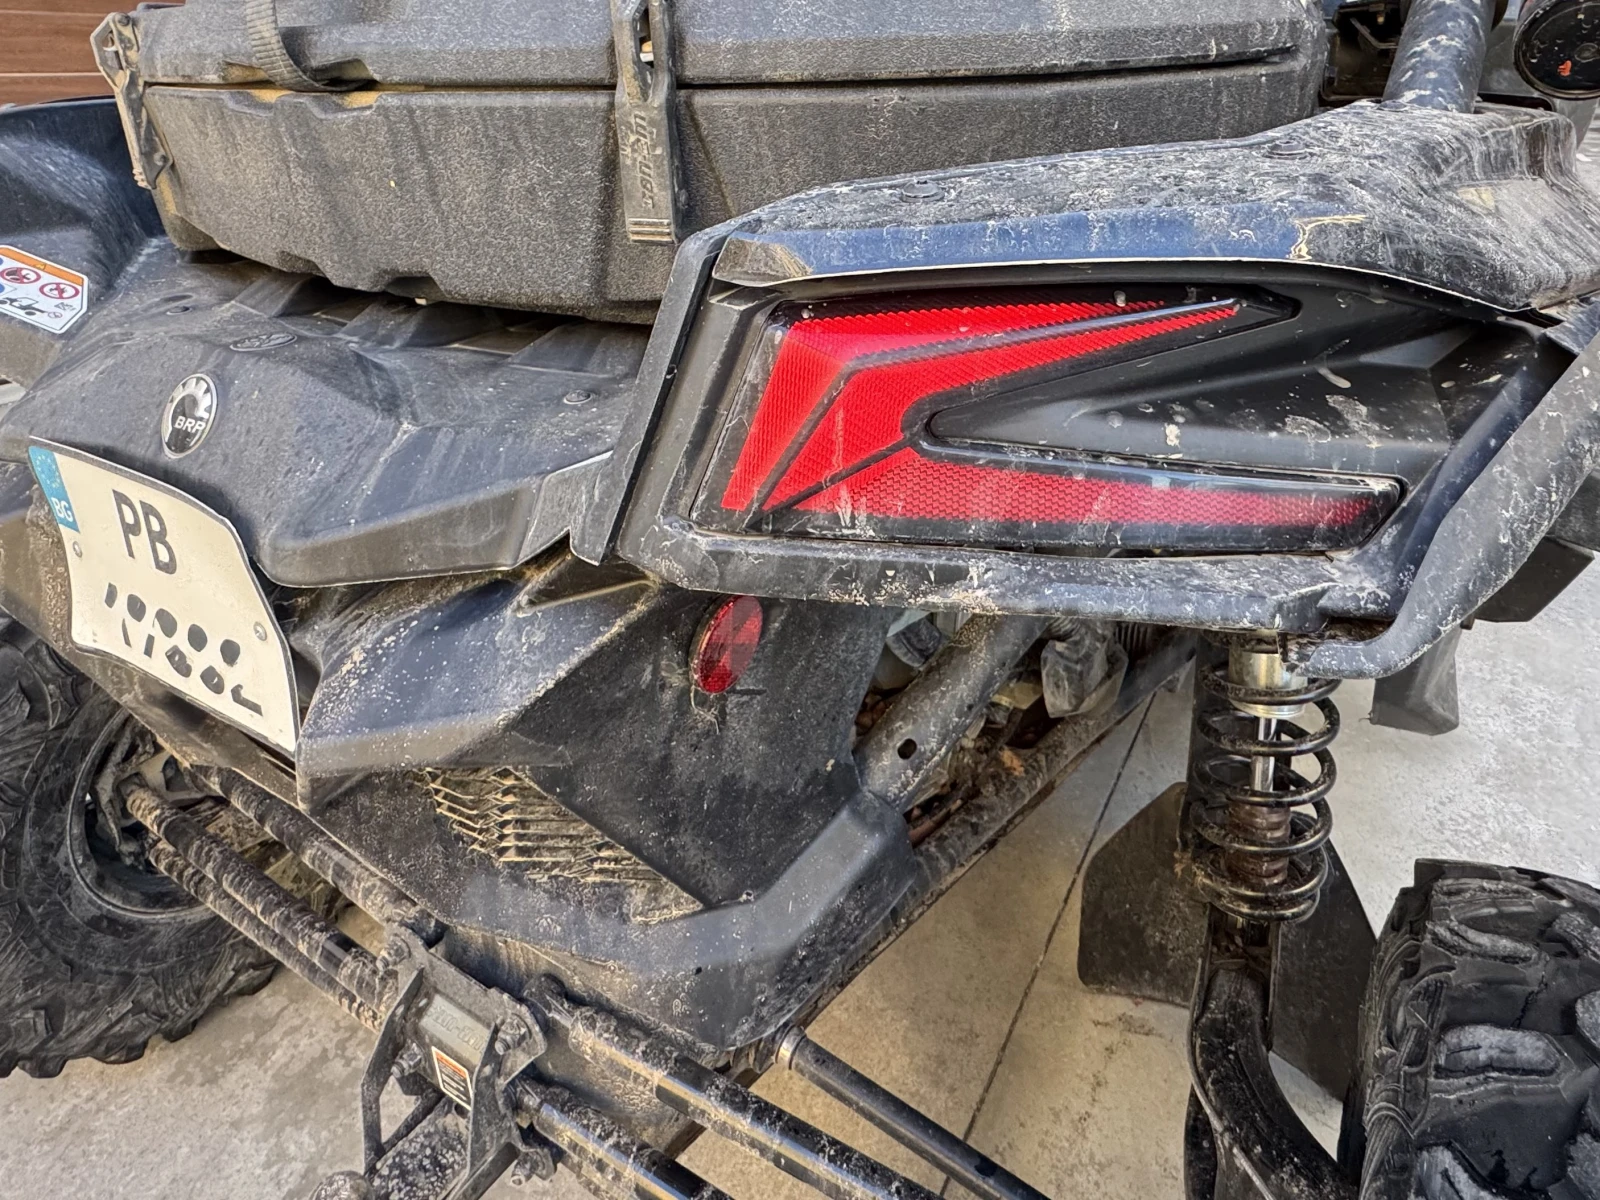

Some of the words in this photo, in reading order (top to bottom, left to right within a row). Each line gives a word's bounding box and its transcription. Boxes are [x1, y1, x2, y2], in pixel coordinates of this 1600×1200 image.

[174, 415, 206, 433] BRP
[51, 497, 74, 522] BG
[112, 489, 177, 574] PB
